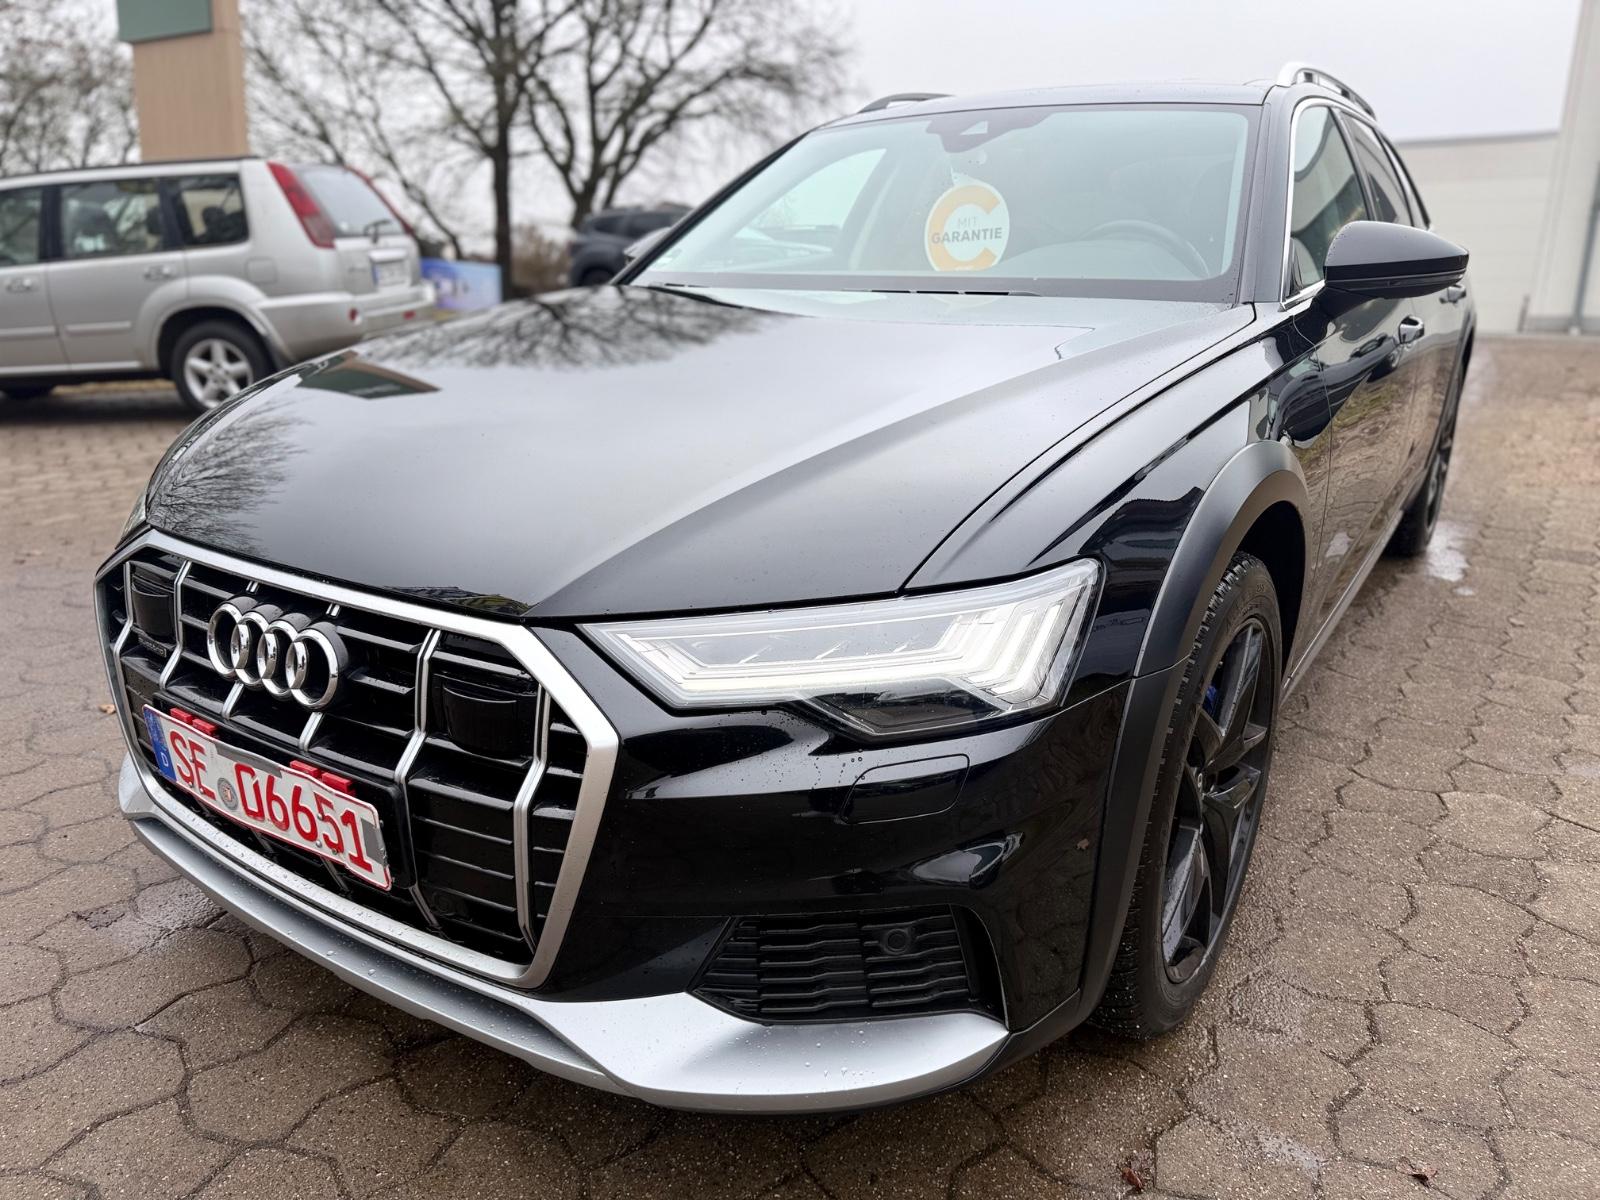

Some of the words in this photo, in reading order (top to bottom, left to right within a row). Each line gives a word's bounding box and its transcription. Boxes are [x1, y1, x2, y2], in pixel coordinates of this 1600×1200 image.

[958, 216, 977, 228] MIT
[931, 227, 1003, 244] GARANTIE
[160, 751, 169, 767] D
[169, 730, 216, 801] SE
